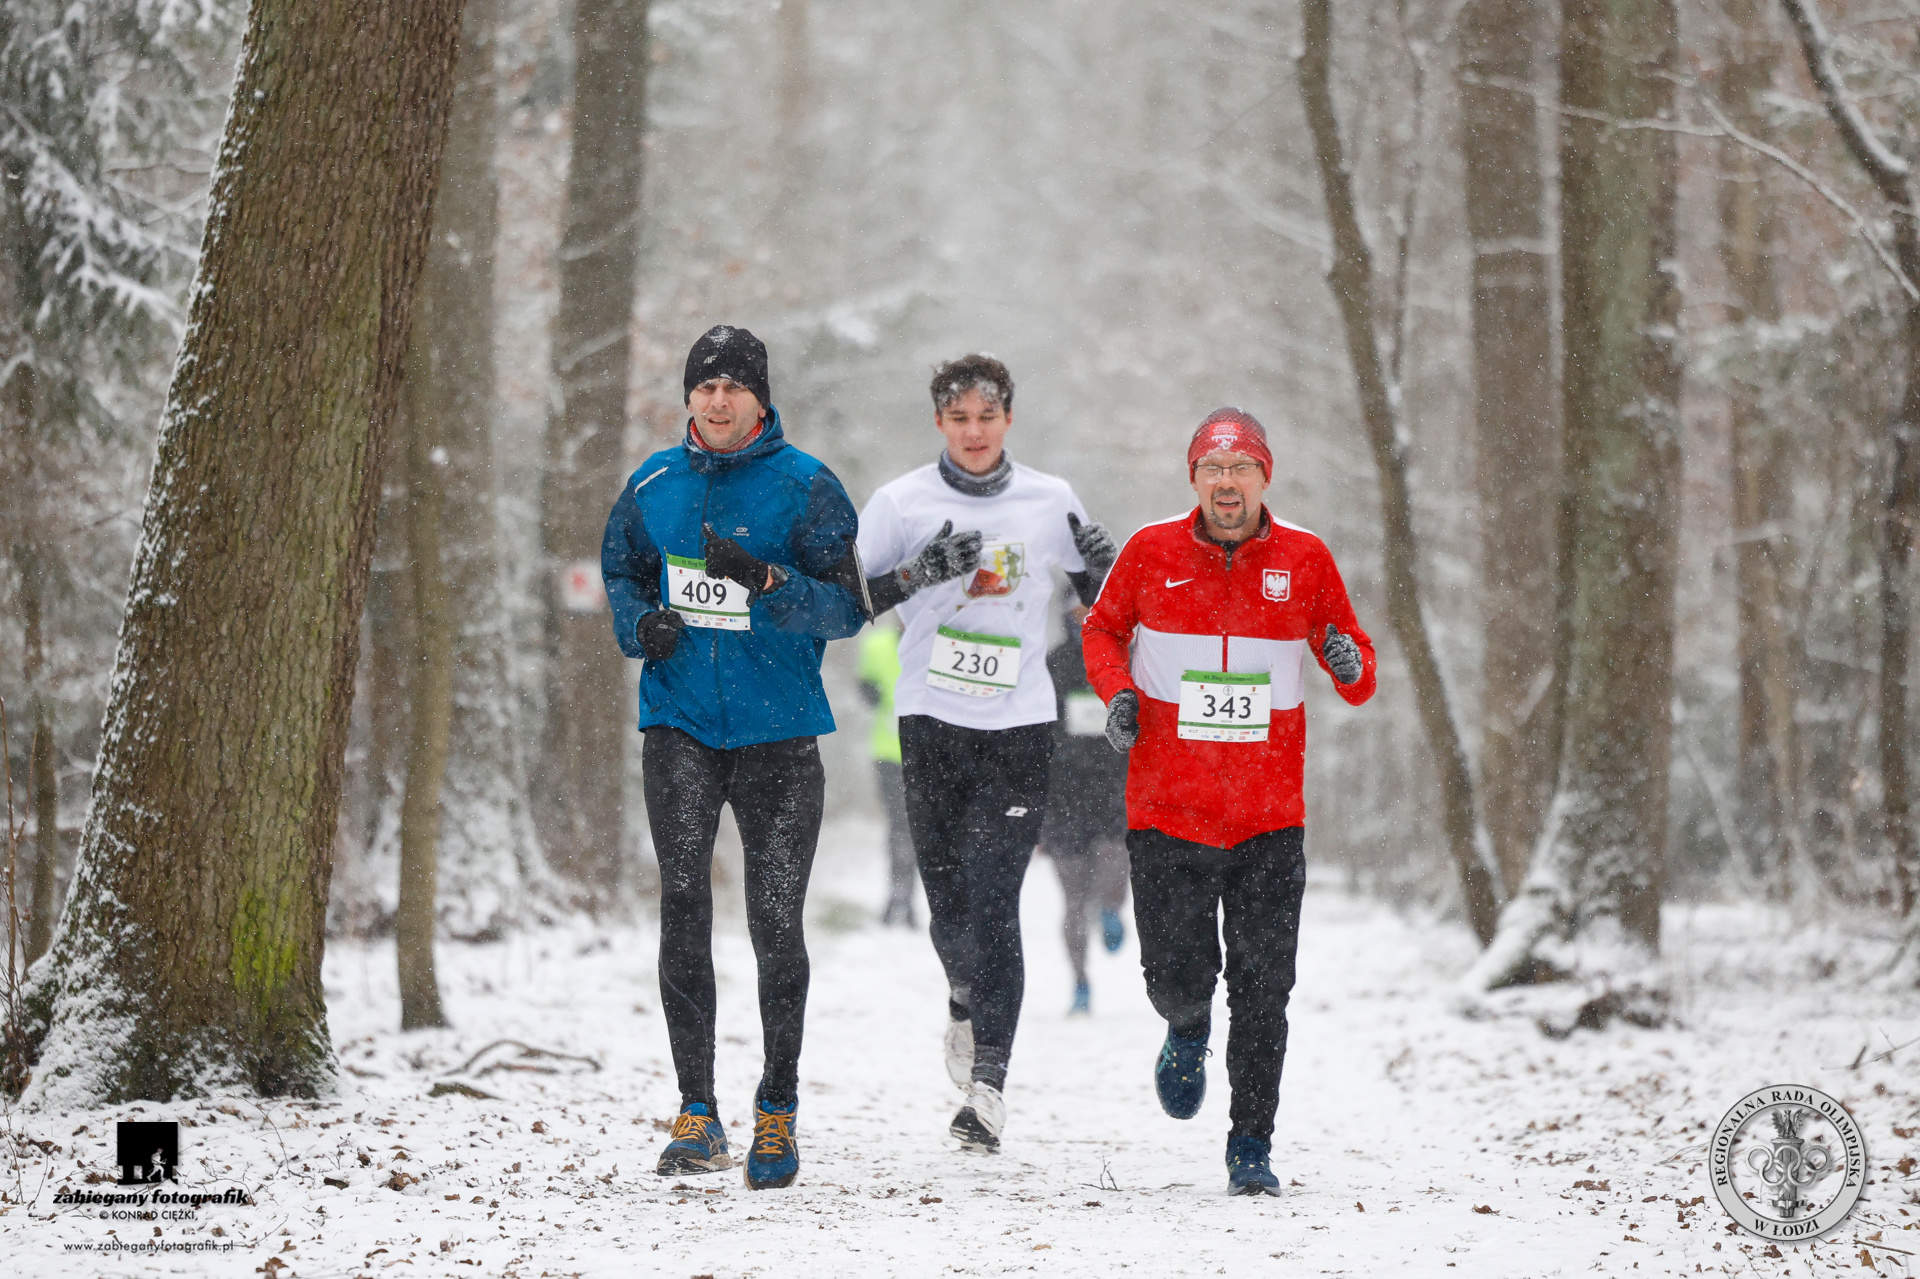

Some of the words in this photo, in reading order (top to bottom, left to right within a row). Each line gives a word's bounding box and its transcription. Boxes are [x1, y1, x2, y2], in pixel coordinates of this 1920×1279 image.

[681, 580, 727, 605] 409
[951, 650, 999, 677] 230
[1202, 694, 1252, 719] 343
